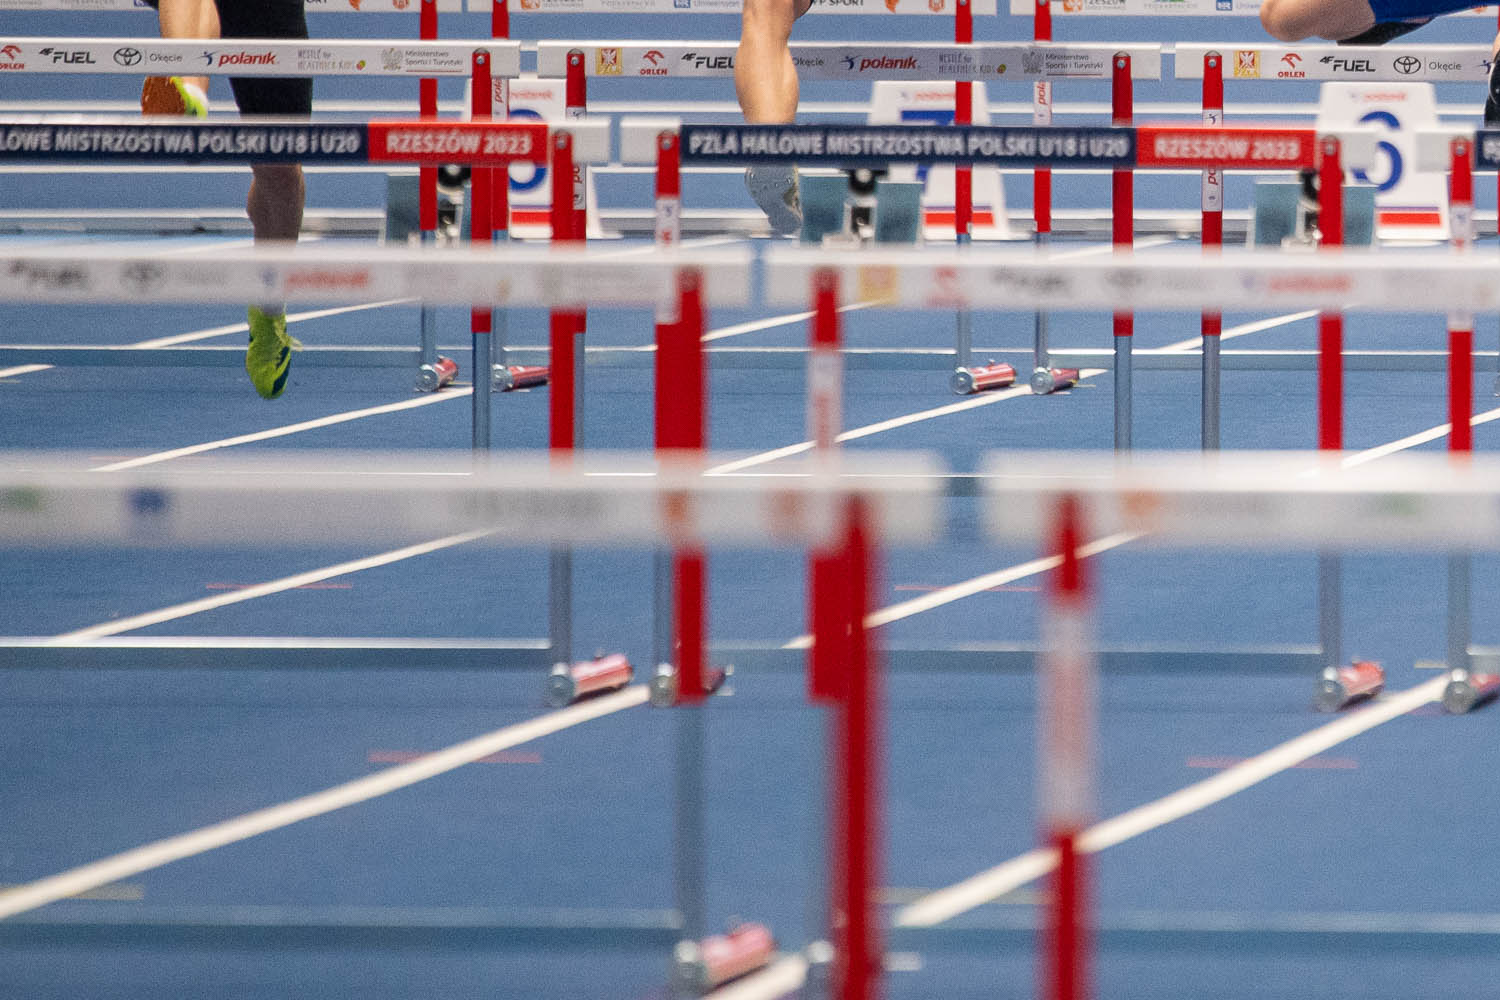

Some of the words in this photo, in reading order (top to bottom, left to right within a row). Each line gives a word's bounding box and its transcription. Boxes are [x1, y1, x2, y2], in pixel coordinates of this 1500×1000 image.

[53, 51, 97, 64] FUEL
[217, 50, 278, 68] polanik
[859, 55, 918, 72] polanik
[1333, 59, 1376, 72] FUEL
[639, 68, 668, 76] ORLEN
[1428, 61, 1462, 72] Okęcie
[0, 132, 50, 153] LOWE
[55, 132, 195, 153] MISTRZOSTWA
[200, 132, 268, 153] POLSKI
[271, 132, 306, 153] U18
[321, 132, 361, 153] U20
[386, 128, 480, 155] RZESZÓW
[483, 133, 533, 155] 2023
[688, 135, 738, 157] PZLA
[741, 135, 822, 157] HALOWE
[825, 135, 965, 157] MISTRZOSTWA
[968, 135, 1036, 157] POLSKI
[1039, 135, 1076, 157] U18
[1089, 135, 1129, 157] U20
[1154, 133, 1248, 160] RZESZÓW
[1252, 138, 1301, 160] 2023
